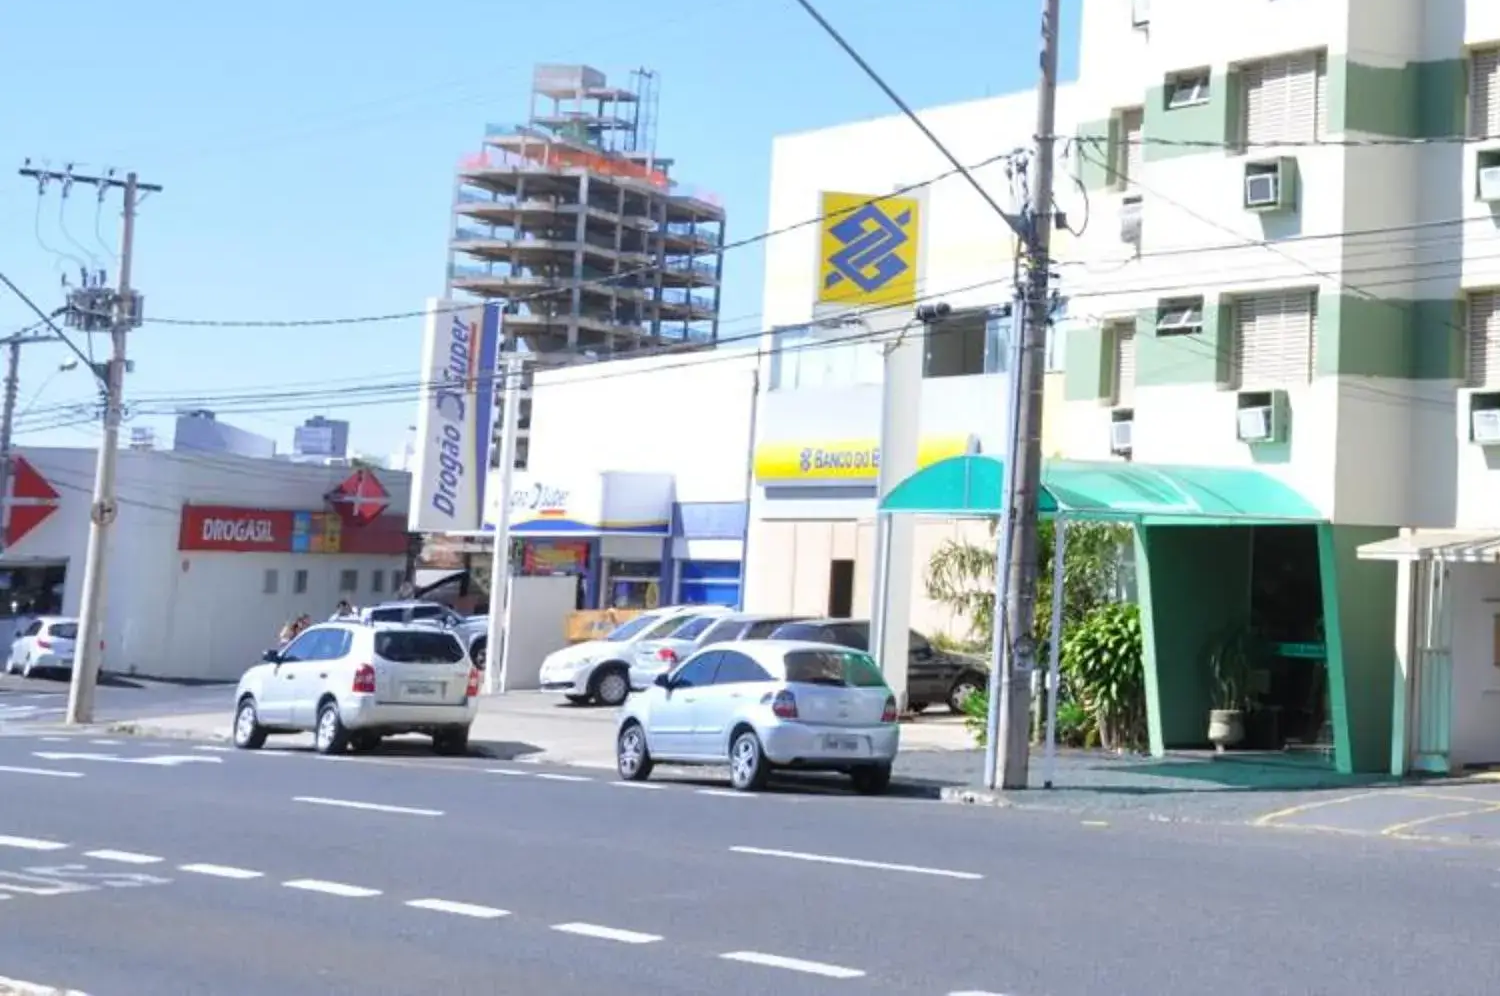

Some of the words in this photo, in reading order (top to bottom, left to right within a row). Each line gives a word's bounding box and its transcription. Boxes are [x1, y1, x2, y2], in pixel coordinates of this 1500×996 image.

[432, 425, 464, 518] Drogão
[815, 449, 853, 469] BANCO
[202, 517, 275, 543] DROGASIL
